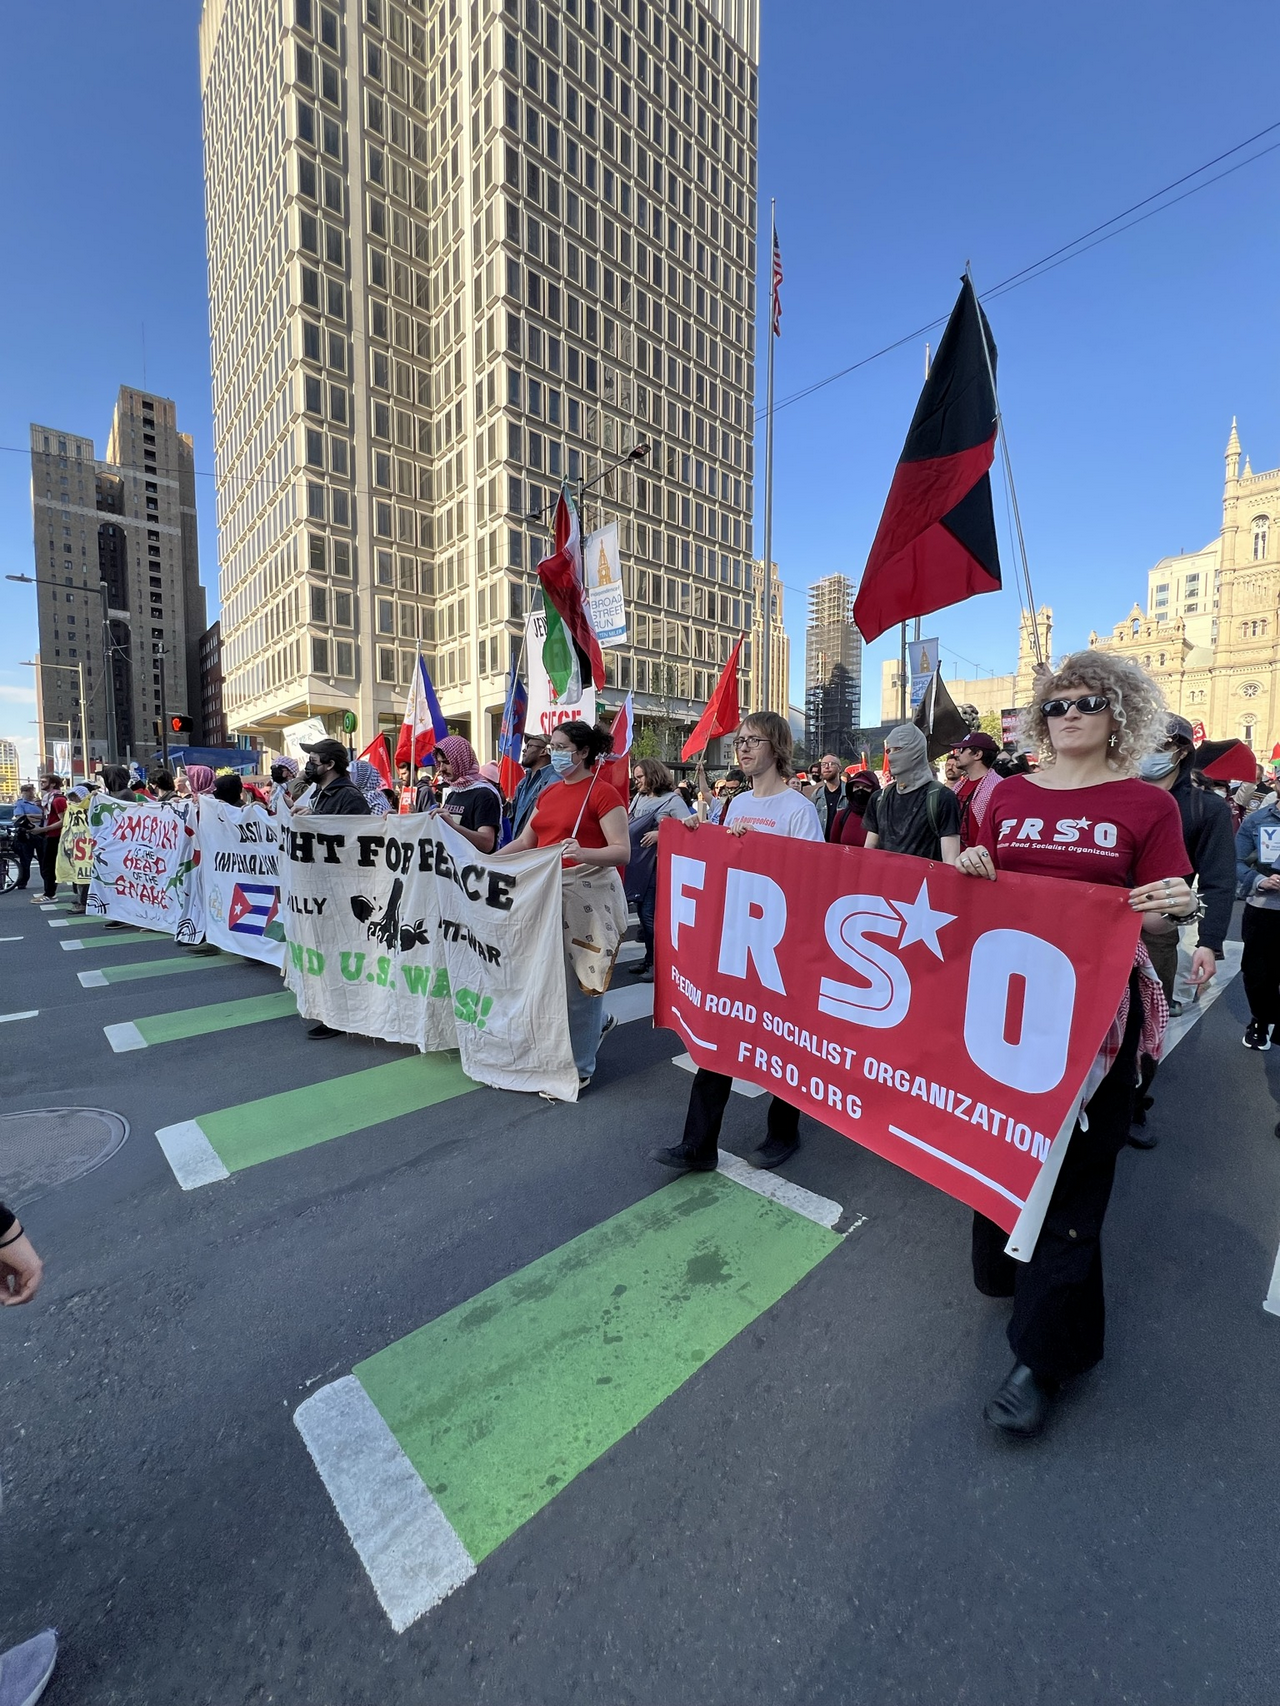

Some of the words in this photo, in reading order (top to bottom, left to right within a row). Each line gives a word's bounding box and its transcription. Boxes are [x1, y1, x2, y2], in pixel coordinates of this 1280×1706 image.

[591, 594, 622, 609] BROAD
[593, 604, 623, 619] STREET
[594, 618, 614, 629] RUN
[357, 836, 414, 875] FOR
[1031, 842, 1065, 851] Socialist
[1068, 845, 1120, 858] Organization
[123, 850, 167, 875] HEAD
[133, 872, 142, 880] OF
[142, 874, 158, 886] THE
[705, 993, 757, 1024] ROAD
[762, 1010, 857, 1070] SOCIALIST
[863, 1056, 1052, 1164] ORGANIZATION
[737, 1041, 862, 1120] FRSO.ORG
